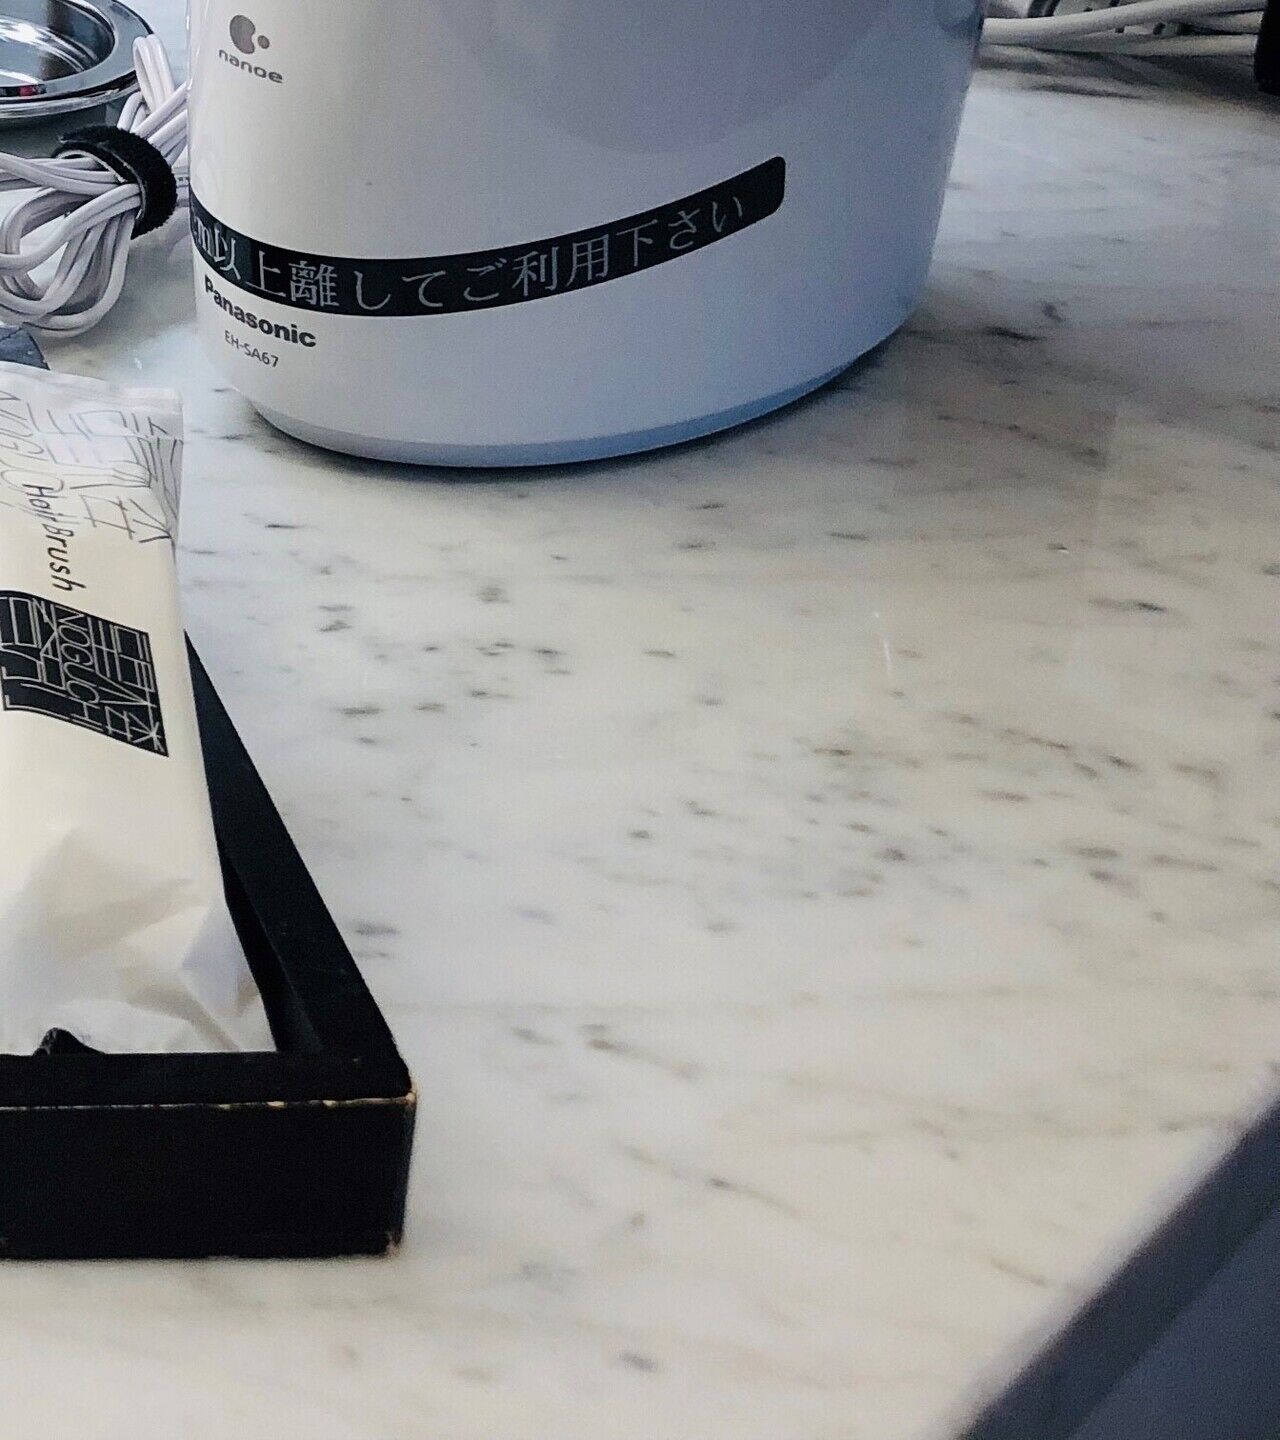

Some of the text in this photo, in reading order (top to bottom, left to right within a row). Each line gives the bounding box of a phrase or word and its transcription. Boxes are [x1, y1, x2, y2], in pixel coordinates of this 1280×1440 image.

[219, 49, 283, 83] nanoe
[205, 274, 316, 347] Panasonic
[225, 330, 279, 367] EH-SA67
[22, 483, 86, 591] Hair Brush
